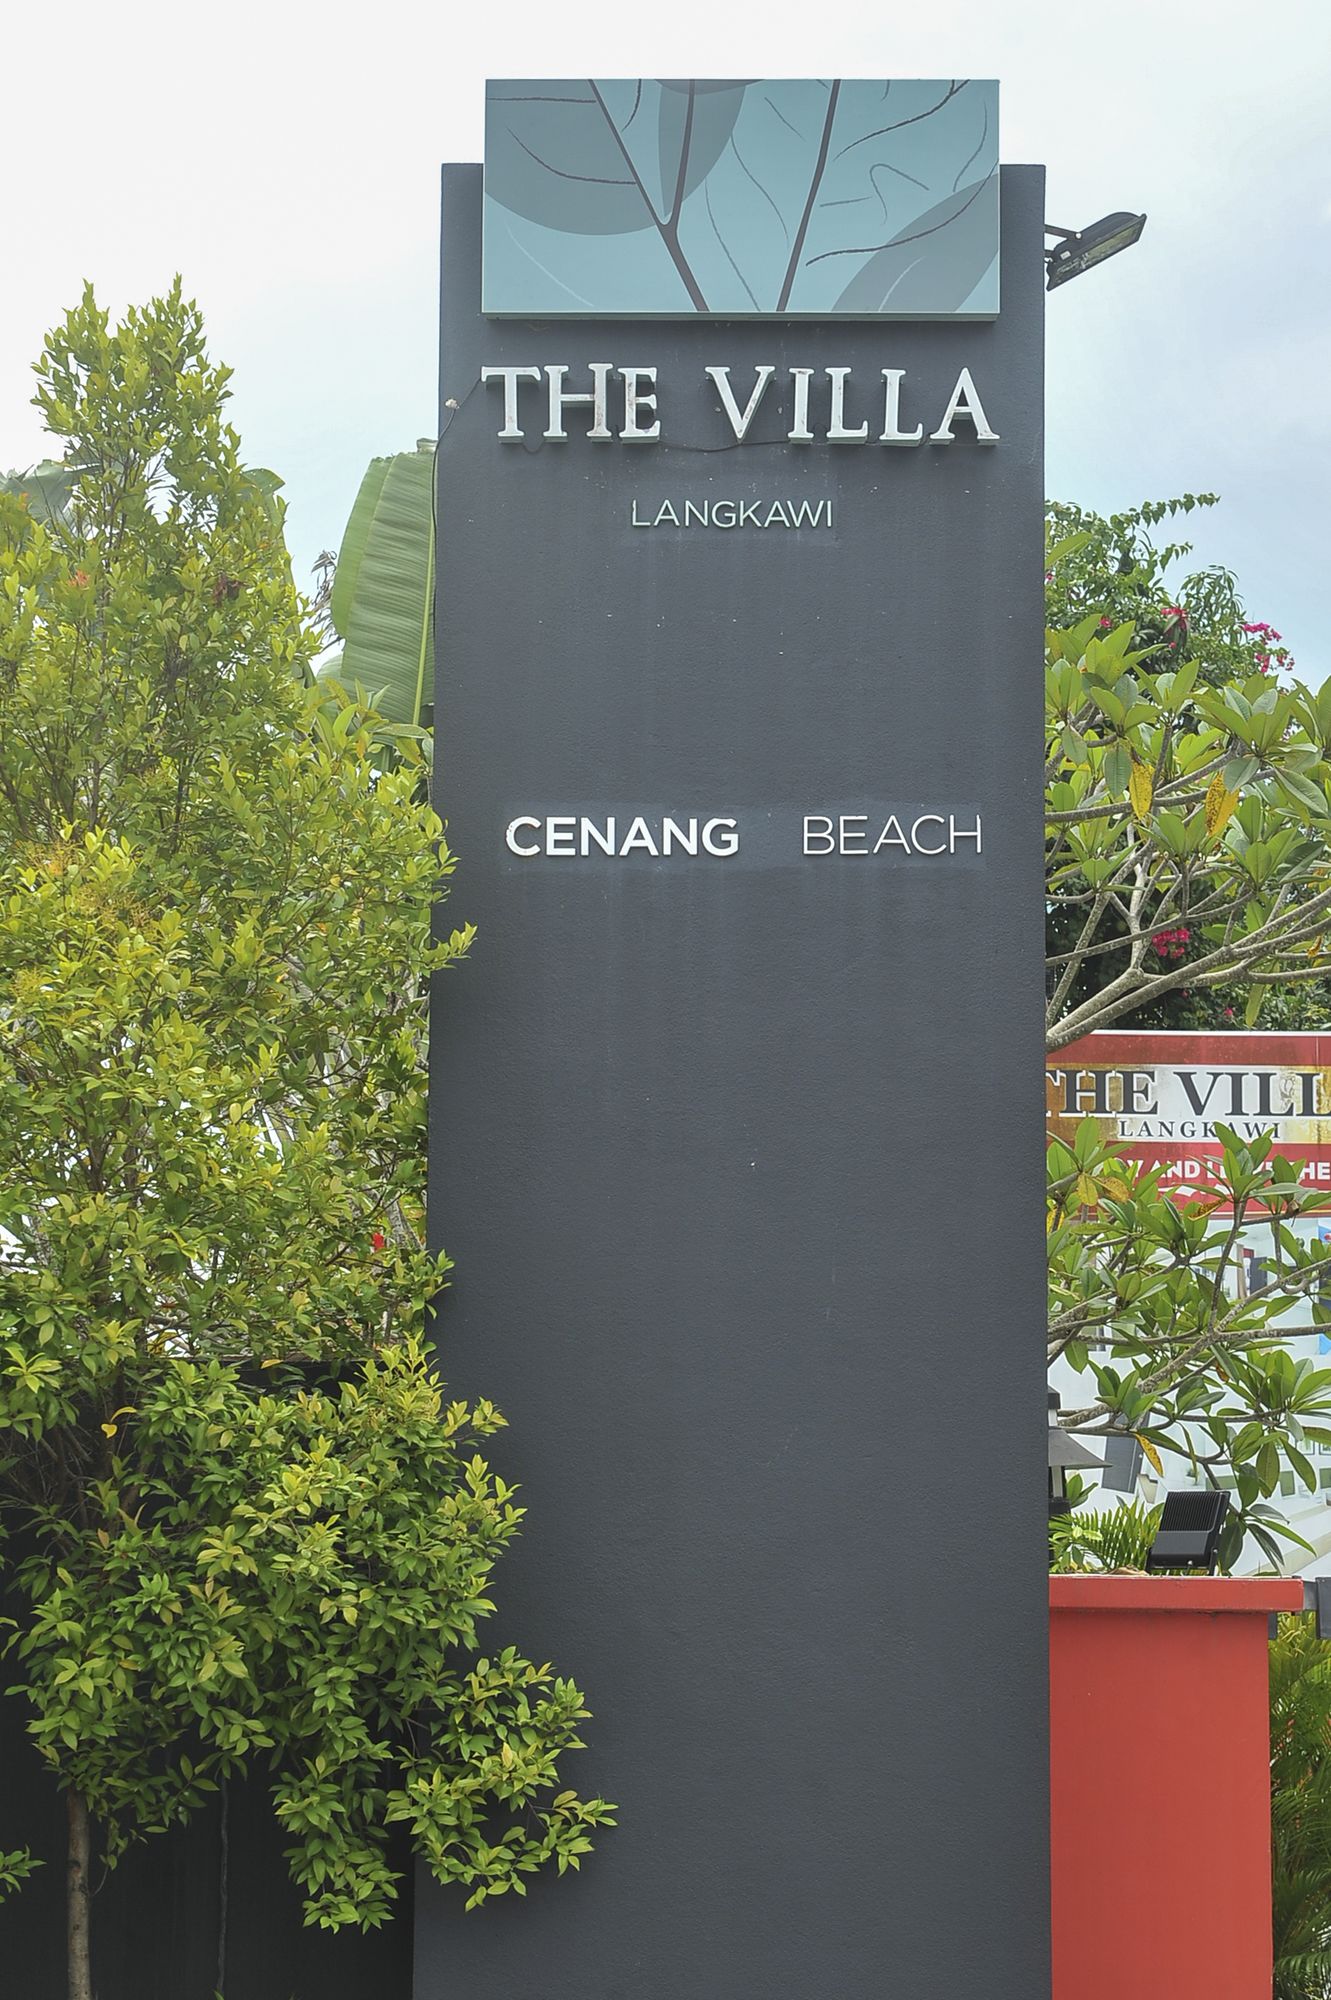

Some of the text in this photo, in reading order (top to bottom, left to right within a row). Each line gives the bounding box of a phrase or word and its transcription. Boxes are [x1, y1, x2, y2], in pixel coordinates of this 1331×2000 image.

[481, 363, 999, 445] THE VILLA
[630, 500, 834, 528] LANGKAWI
[505, 814, 983, 857] CENANG BEACH
[1289, 1161, 1331, 1180] HE
